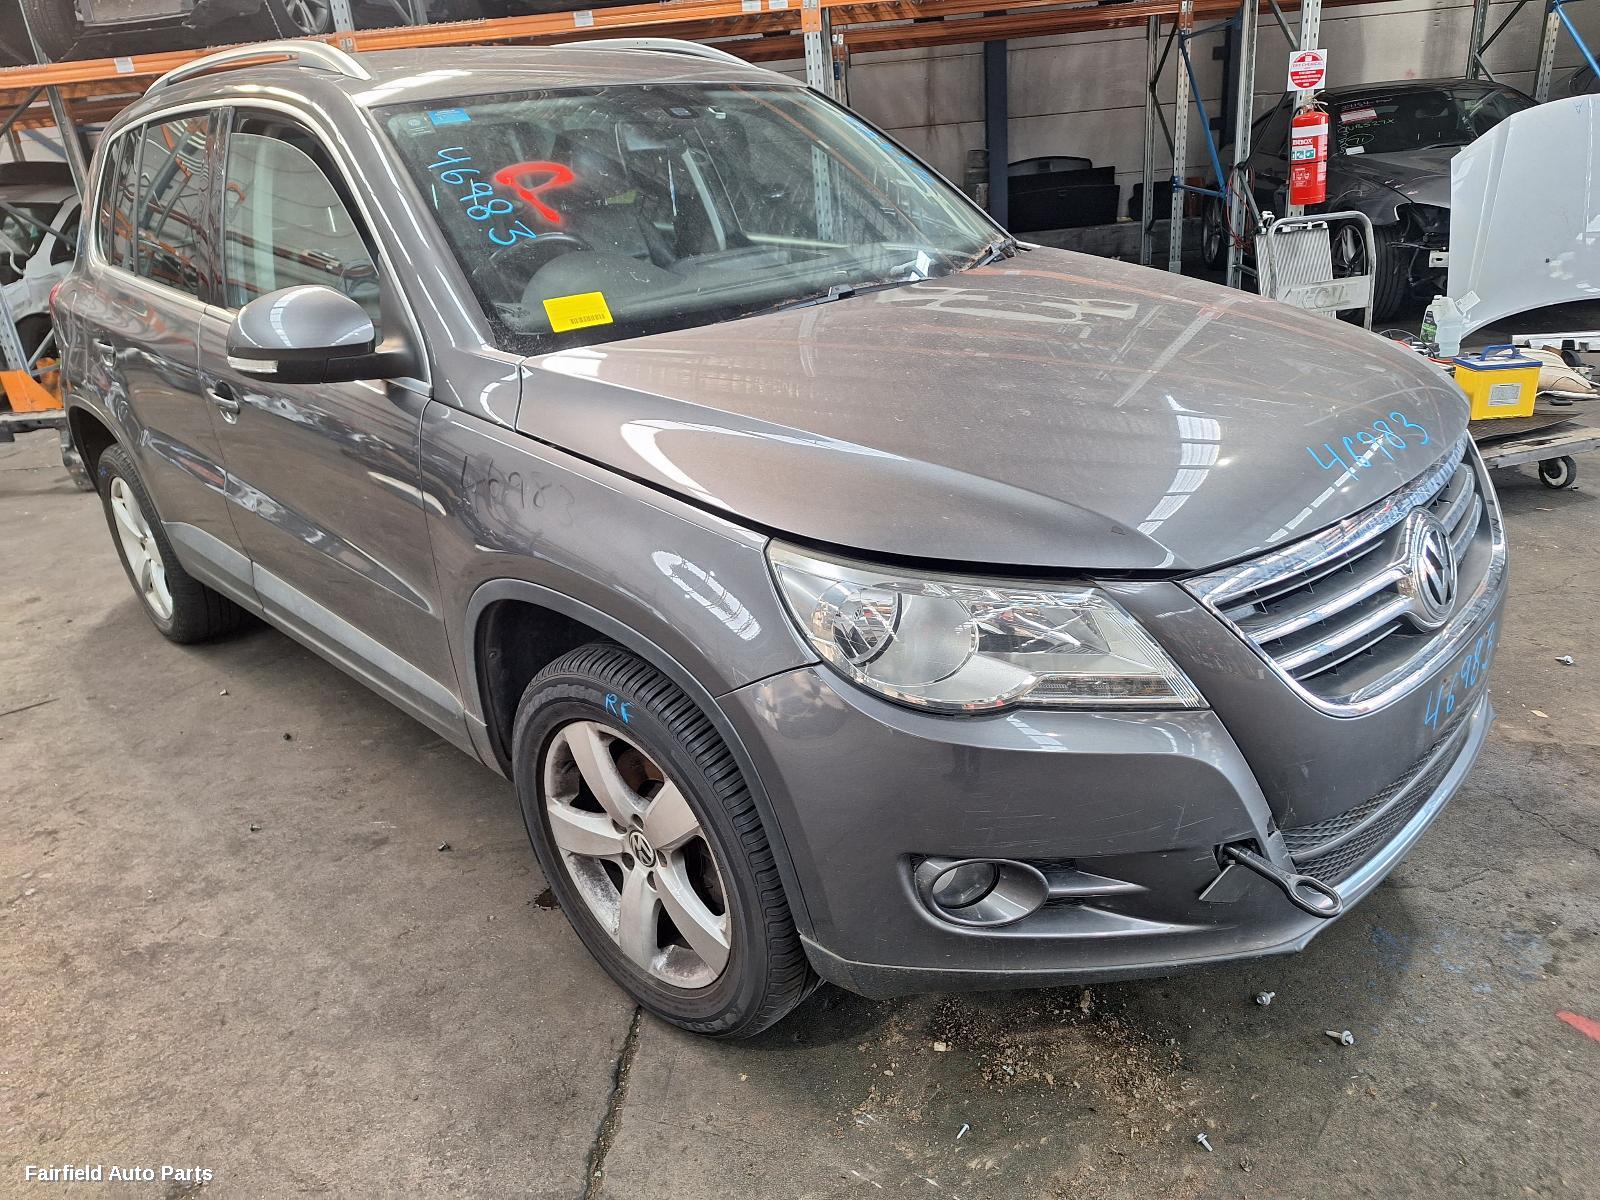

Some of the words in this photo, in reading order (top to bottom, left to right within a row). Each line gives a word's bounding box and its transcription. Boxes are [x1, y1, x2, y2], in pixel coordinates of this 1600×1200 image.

[427, 147, 537, 246] 46983
[1304, 411, 1430, 481] 46983
[604, 692, 636, 725] RF
[1424, 621, 1495, 731] 46983
